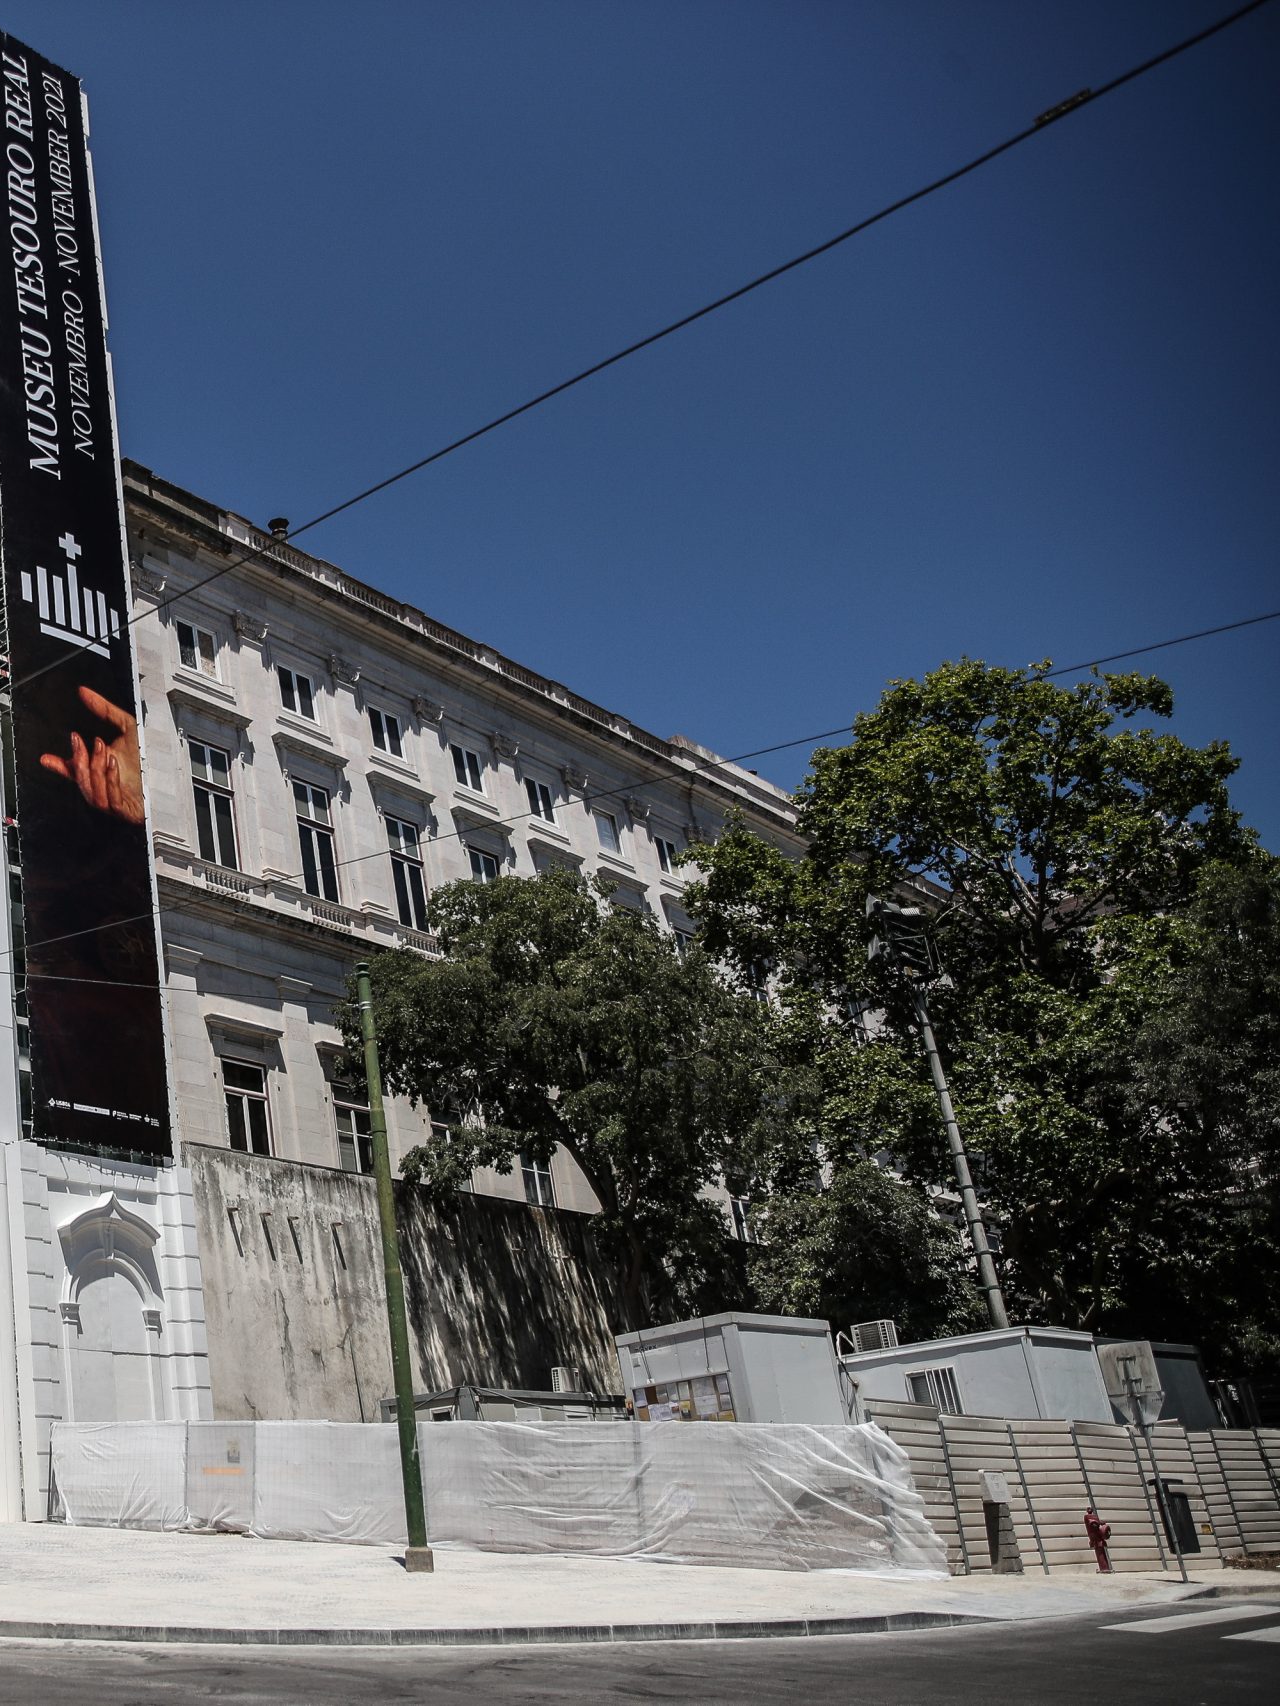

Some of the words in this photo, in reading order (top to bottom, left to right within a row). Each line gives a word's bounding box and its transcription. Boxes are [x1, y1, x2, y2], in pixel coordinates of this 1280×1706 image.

[2, 51, 34, 142] REAL
[41, 72, 67, 129] 2021
[6, 143, 48, 320] TESOURO
[48, 129, 81, 276] NOVEMBER
[20, 321, 61, 481] MUSEU
[62, 290, 95, 461] NOVEMBRO
